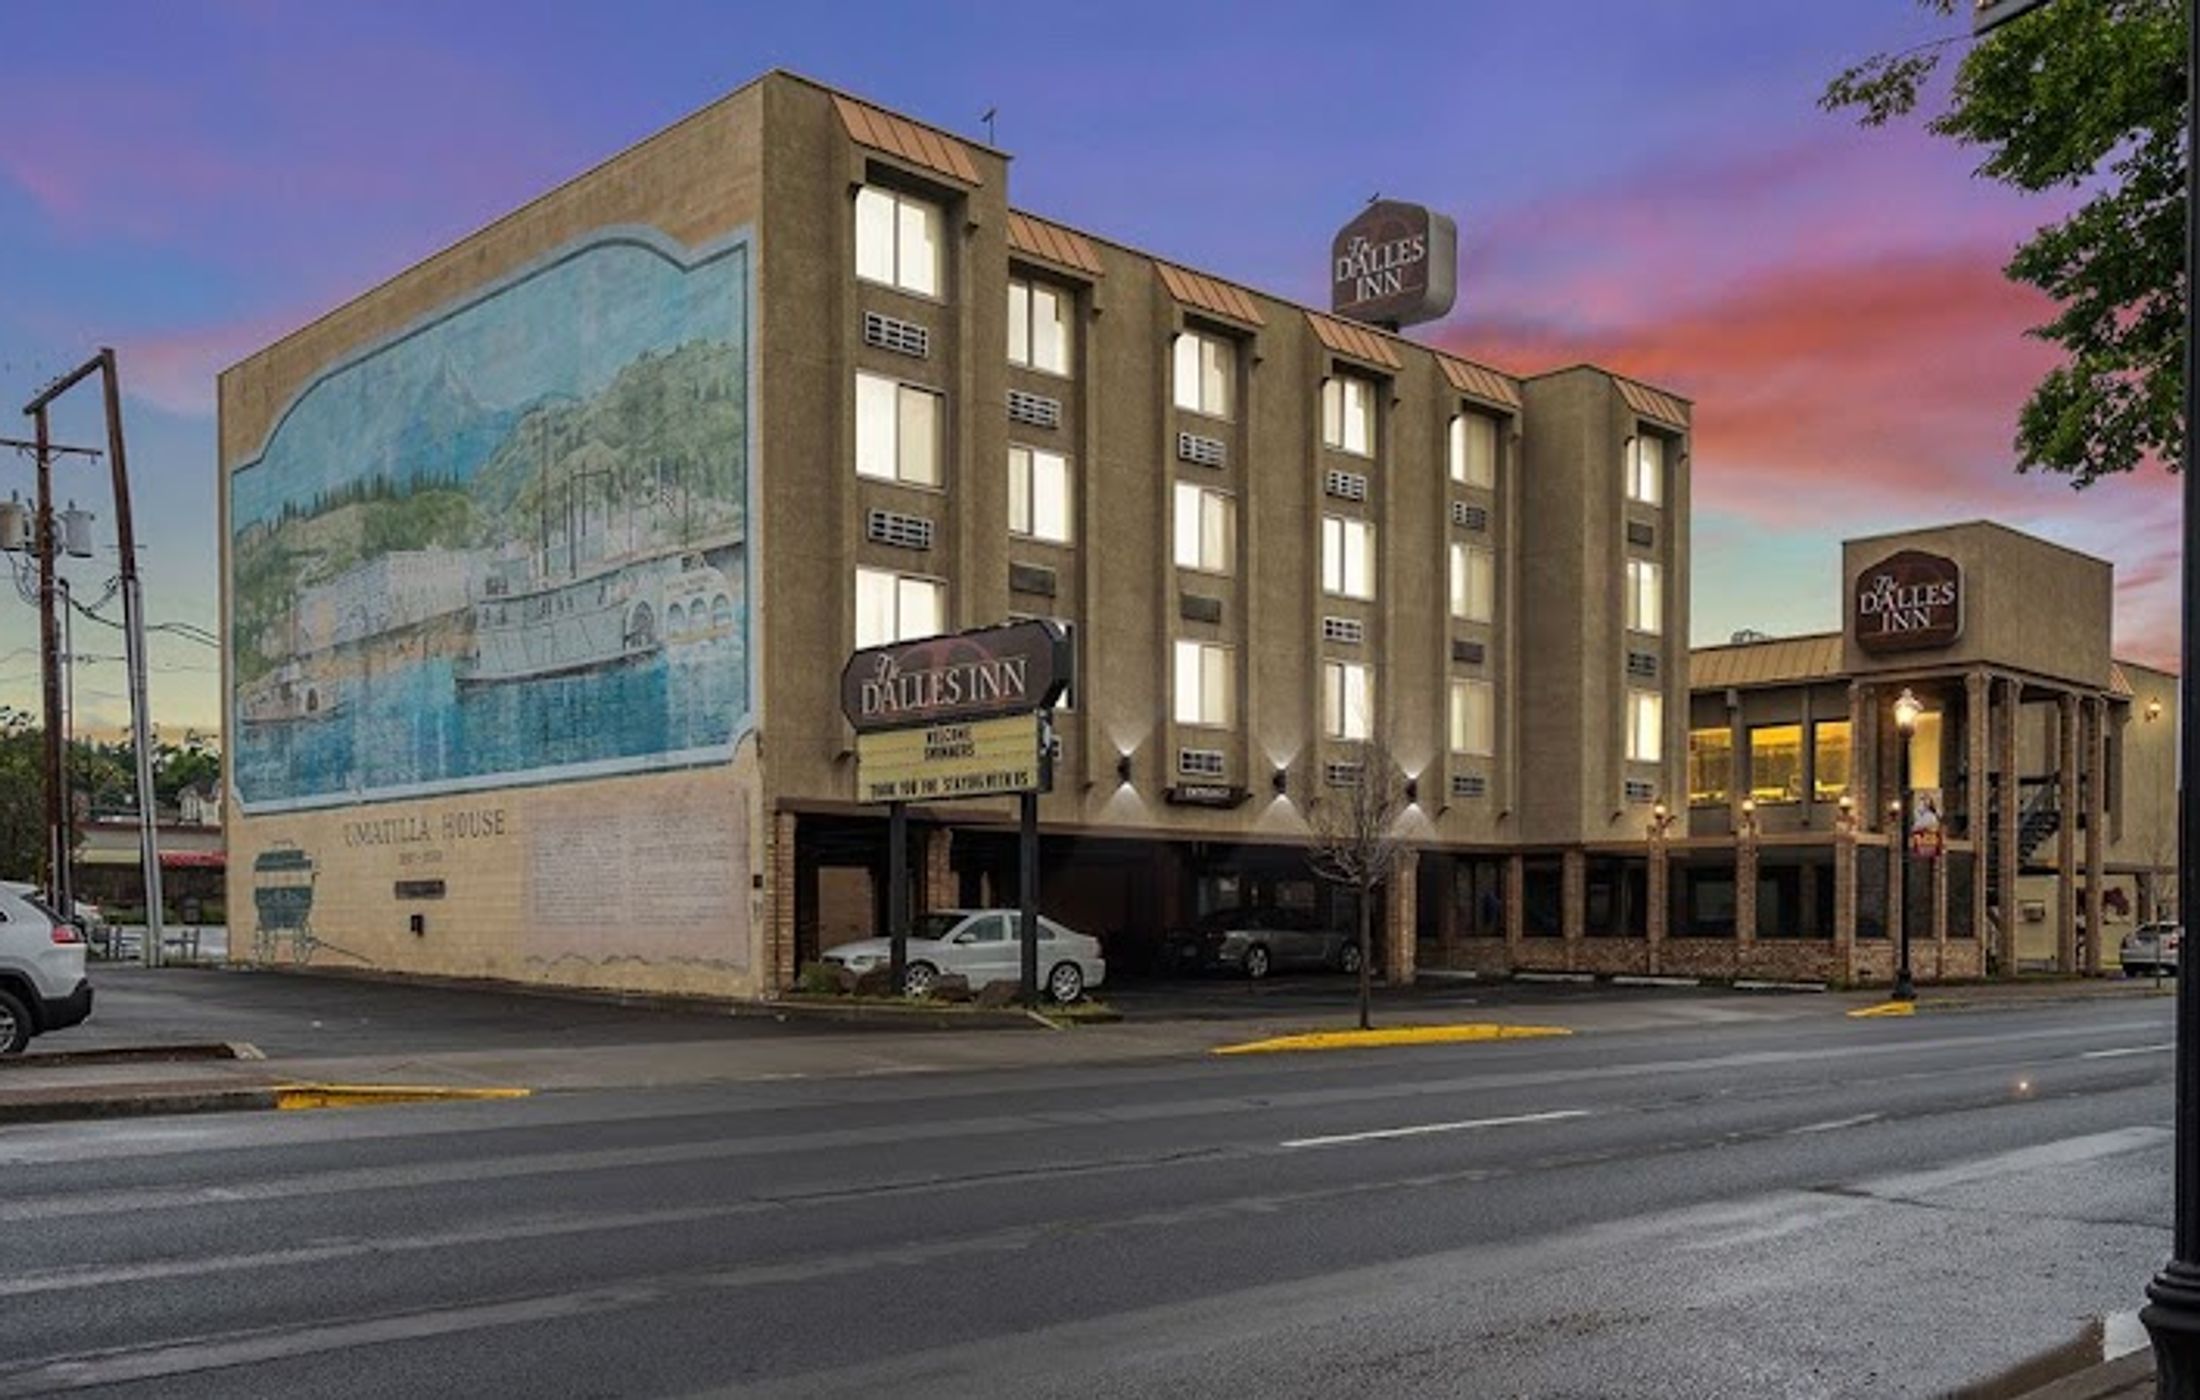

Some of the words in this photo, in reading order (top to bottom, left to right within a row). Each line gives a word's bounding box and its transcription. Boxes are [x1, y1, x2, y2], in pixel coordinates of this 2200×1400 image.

[1336, 234, 1425, 282] DALLES
[1356, 267, 1402, 302] INN
[1860, 581, 1956, 615] DALLES
[1881, 607, 1931, 634] INN
[861, 668, 961, 715] DALLES
[969, 655, 1029, 701] INN
[1014, 770, 1029, 786] US
[343, 817, 432, 847] UMATILLA
[442, 809, 505, 840] HOUSE
